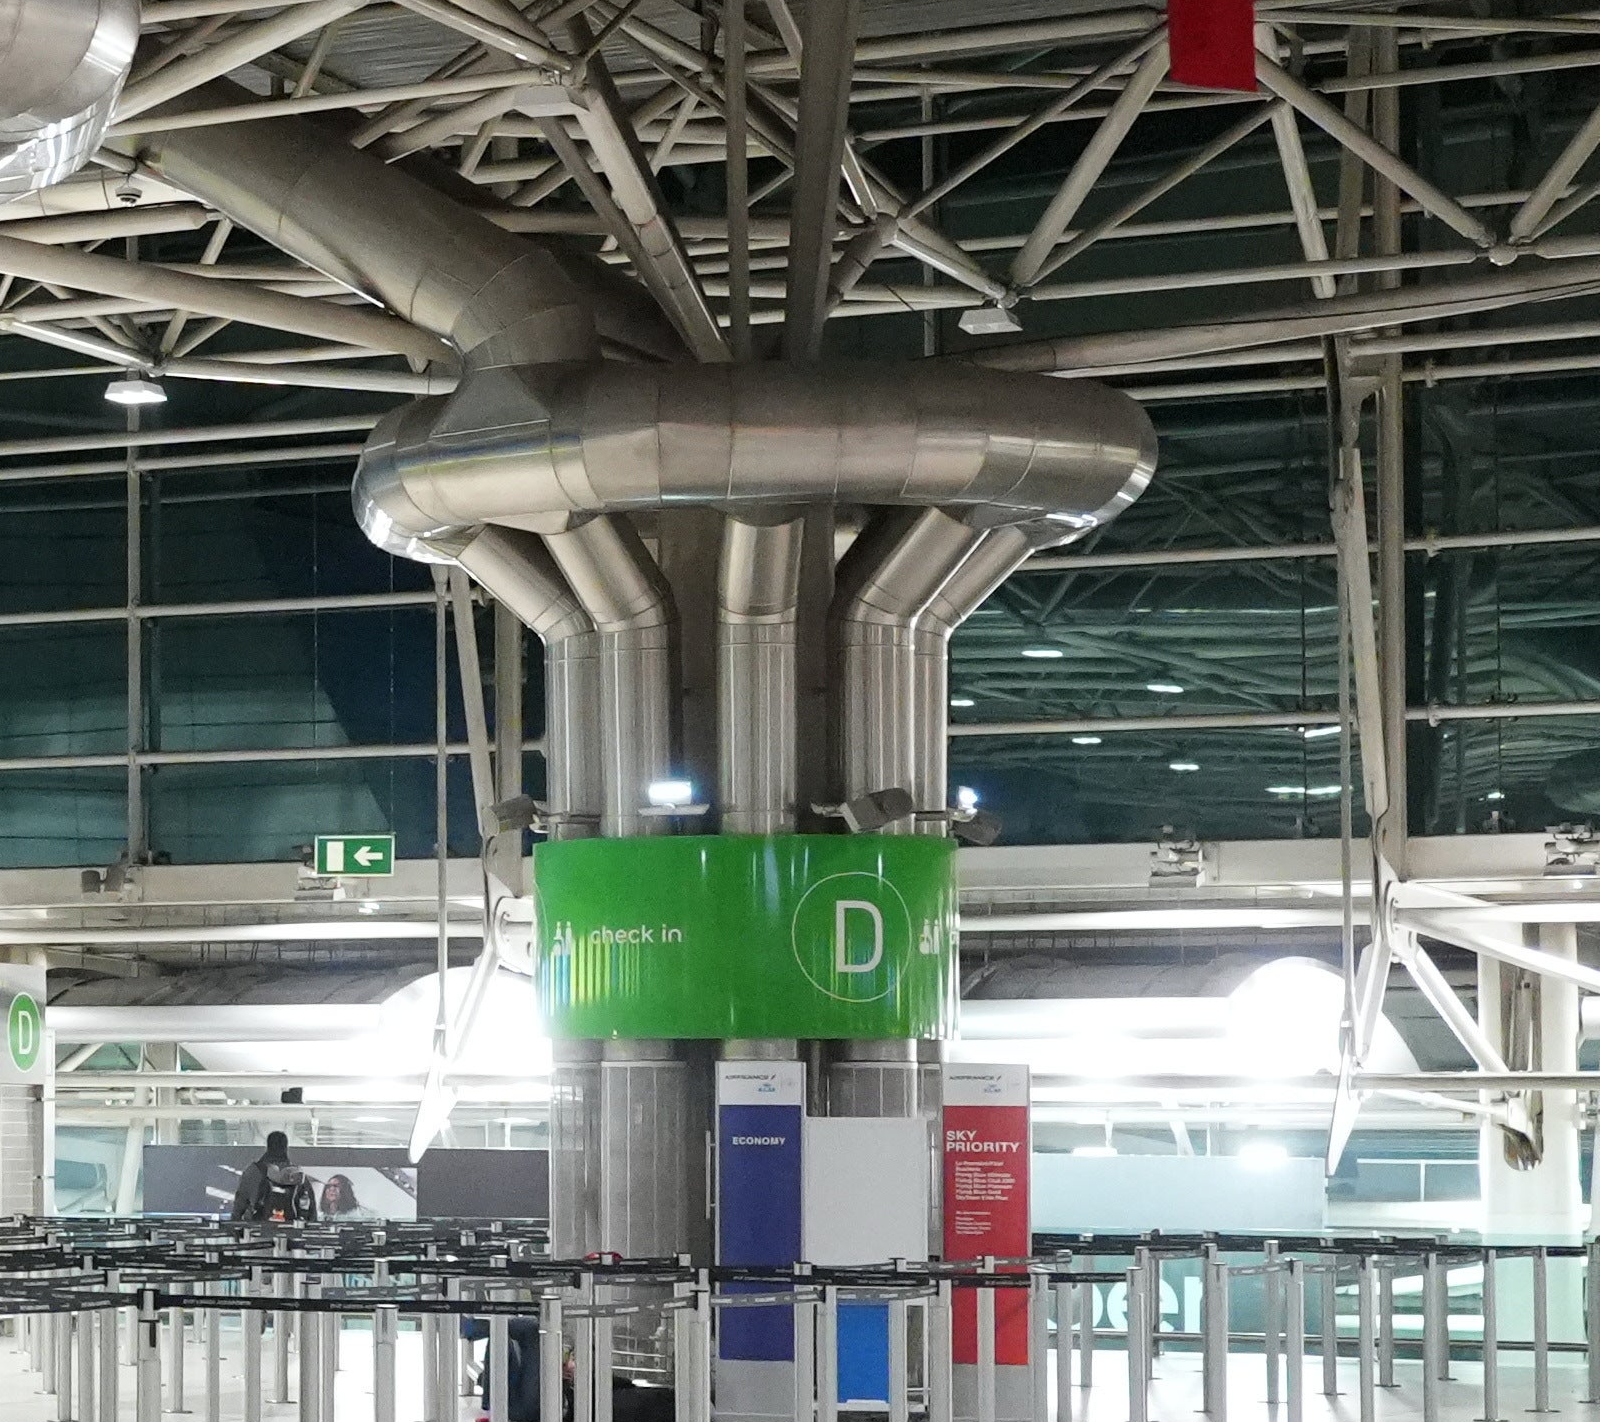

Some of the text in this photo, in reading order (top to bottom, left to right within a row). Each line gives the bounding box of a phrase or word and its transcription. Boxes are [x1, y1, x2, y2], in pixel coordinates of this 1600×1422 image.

[590, 924, 683, 945] check in
[835, 900, 884, 973] D
[18, 1010, 33, 1055] D
[732, 1136, 786, 1146] ECONOMY
[946, 1130, 977, 1141] SKY
[946, 1141, 1020, 1153] PRIORITY
